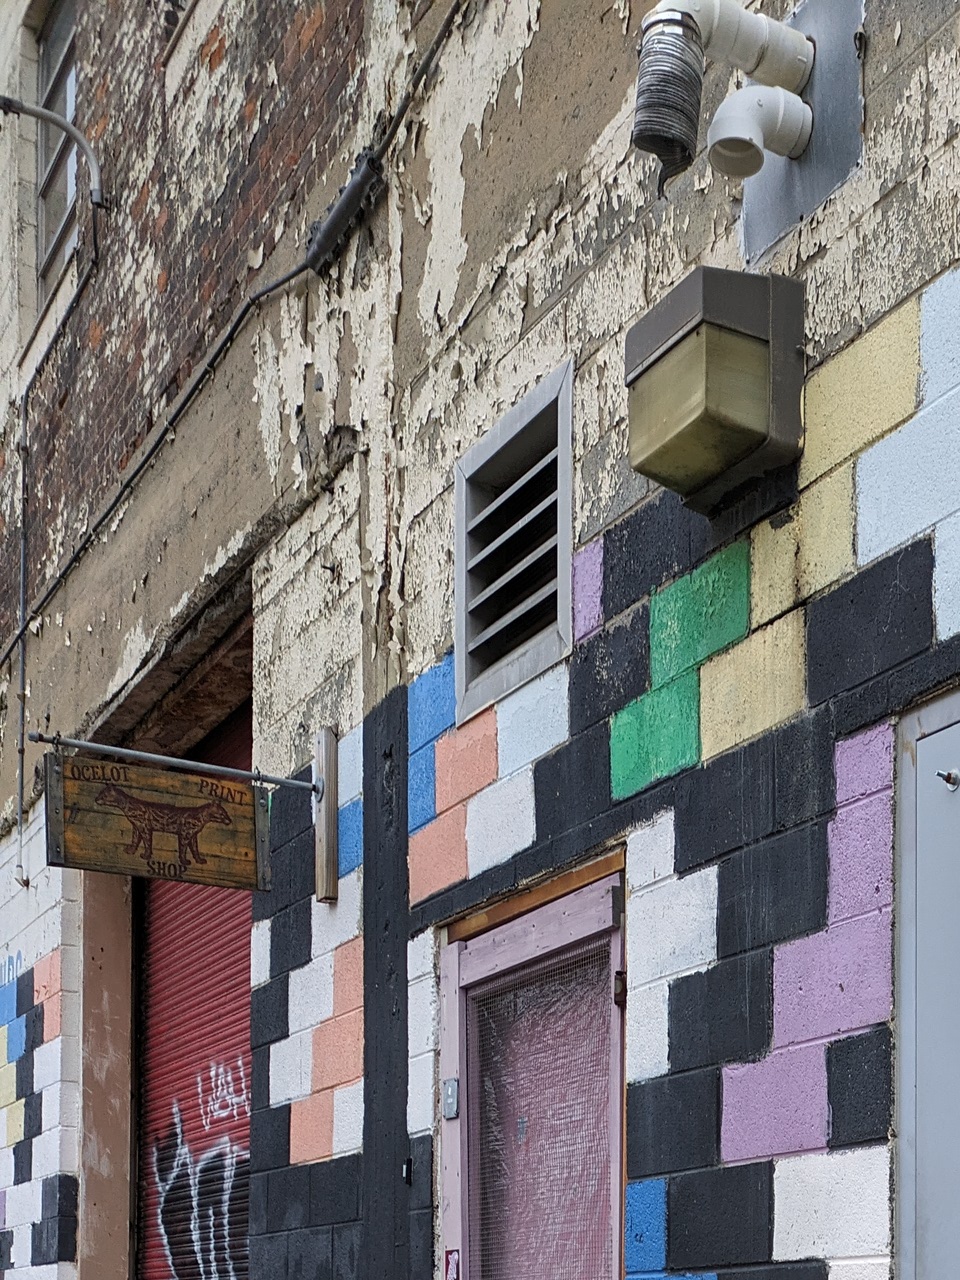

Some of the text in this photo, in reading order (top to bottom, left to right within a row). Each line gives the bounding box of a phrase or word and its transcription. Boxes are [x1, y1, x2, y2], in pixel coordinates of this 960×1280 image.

[71, 764, 130, 782] OCELOT
[198, 778, 248, 805] PRINT
[146, 860, 187, 878] SHOP
